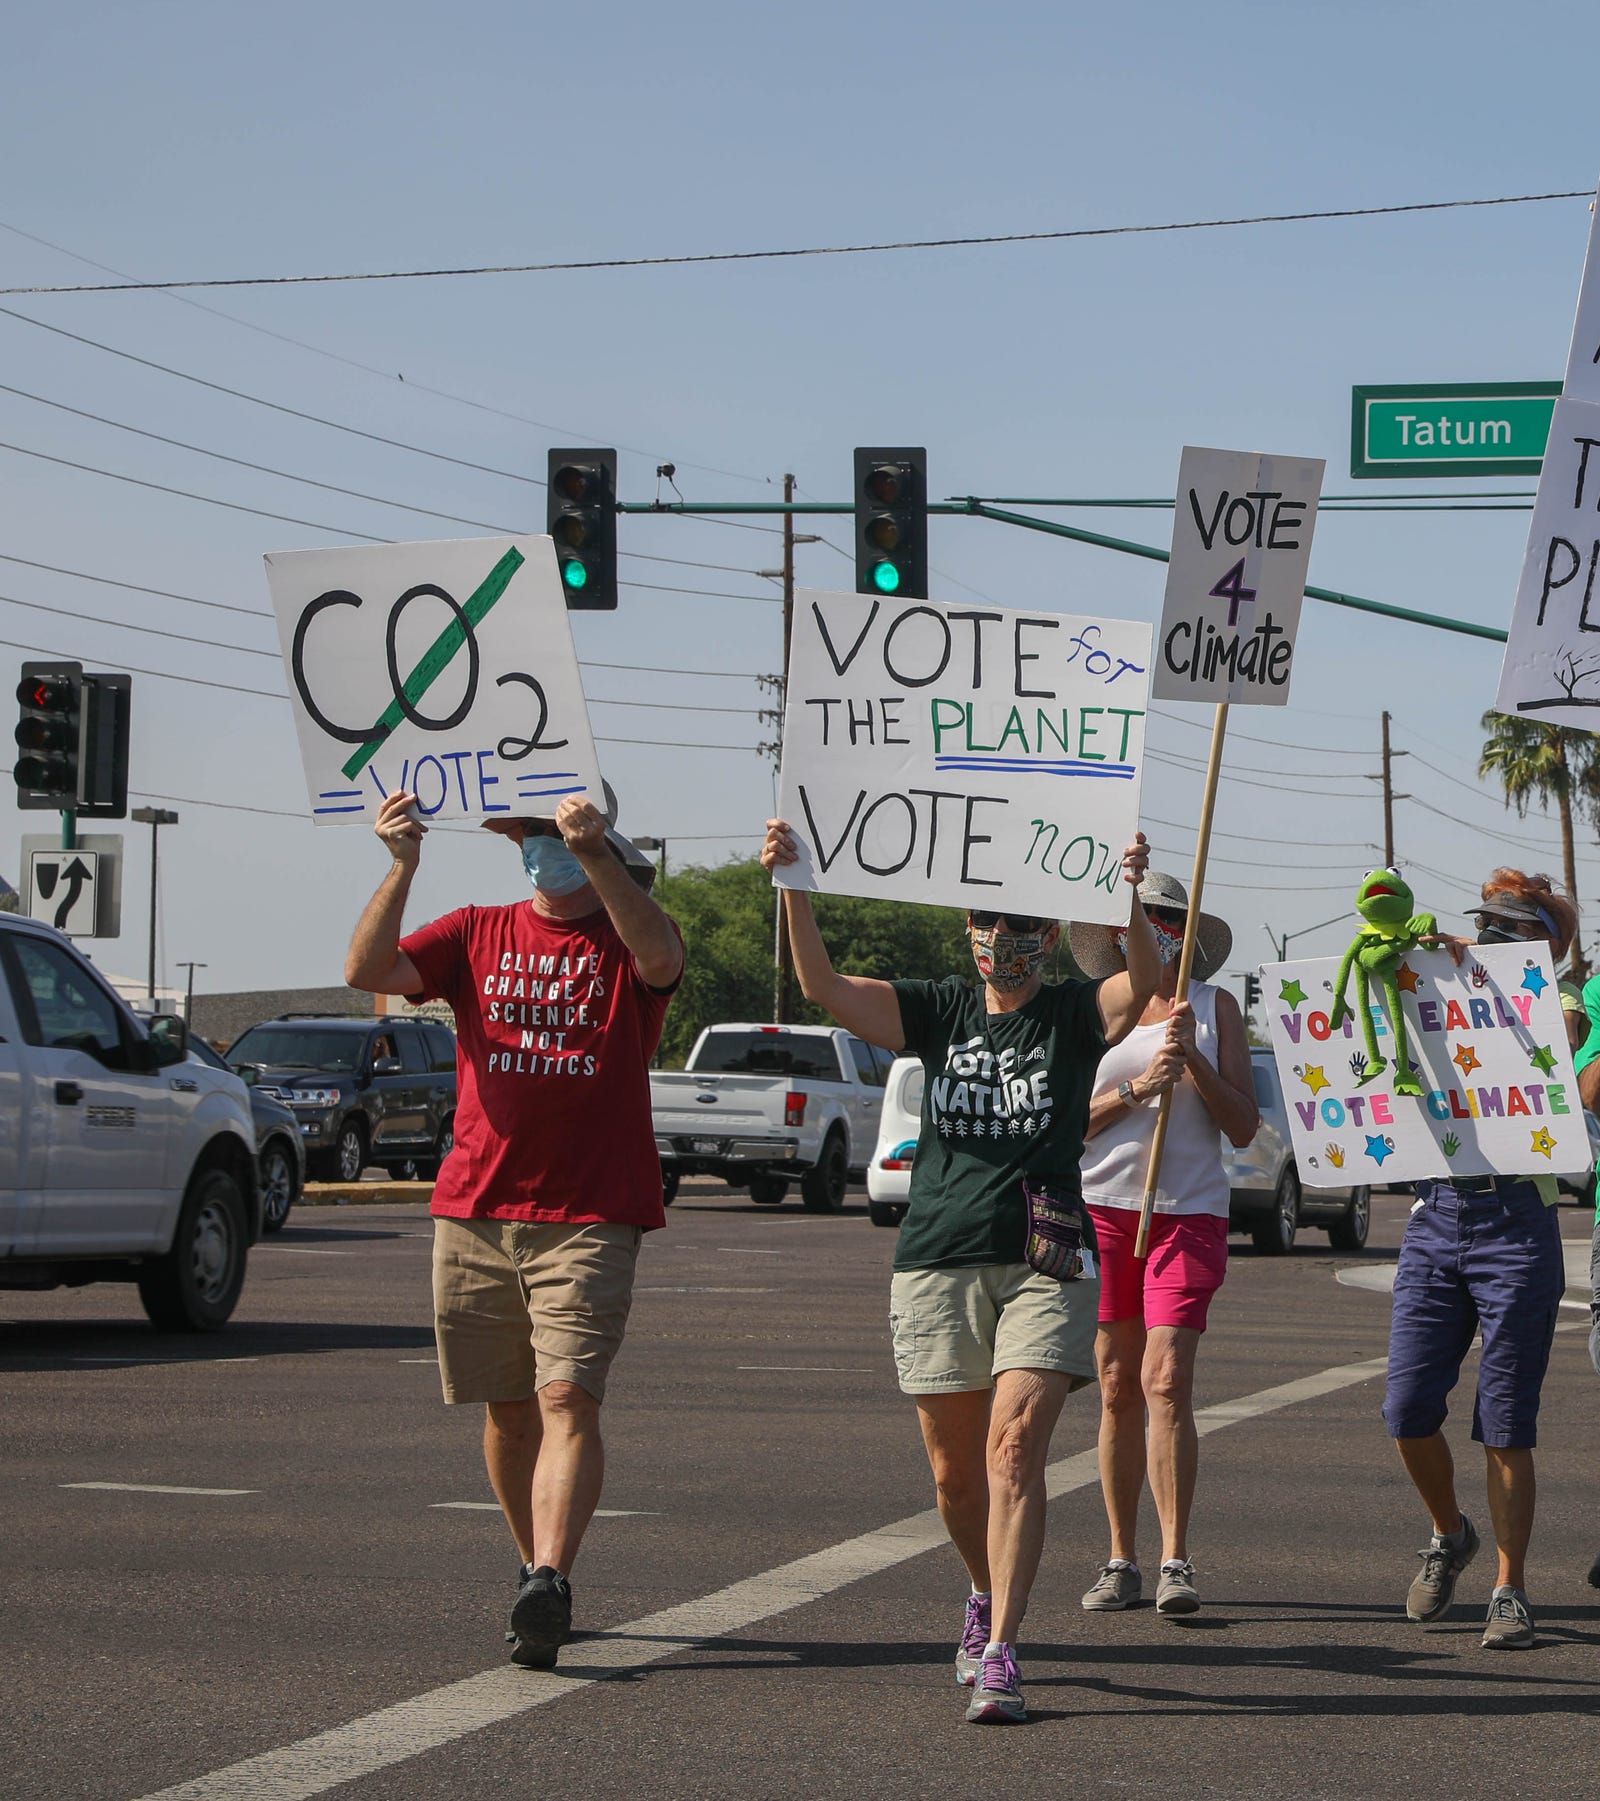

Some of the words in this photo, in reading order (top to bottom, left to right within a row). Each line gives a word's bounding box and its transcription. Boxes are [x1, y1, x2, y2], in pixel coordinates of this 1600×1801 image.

[1395, 415, 1512, 446] Tatum
[1189, 488, 1307, 550] VOTE
[1208, 557, 1256, 627] 4
[812, 600, 1059, 699] VOTE
[805, 697, 911, 745] THE
[931, 698, 1145, 761] PLANET
[368, 751, 511, 815] VOTE
[798, 784, 1009, 887] VOTE
[500, 951, 599, 976] CLIMATE
[483, 975, 575, 1000] CHANGE
[587, 976, 605, 998] IS
[488, 1002, 598, 1027] SCIENCE,
[1418, 995, 1534, 1032] EARLY
[488, 1052, 596, 1076] POLITICS
[520, 1030, 567, 1052] NOT
[930, 1070, 1053, 1125] NATURE
[1295, 1093, 1395, 1131] VOTE
[1427, 1084, 1570, 1121] CLIMATE
